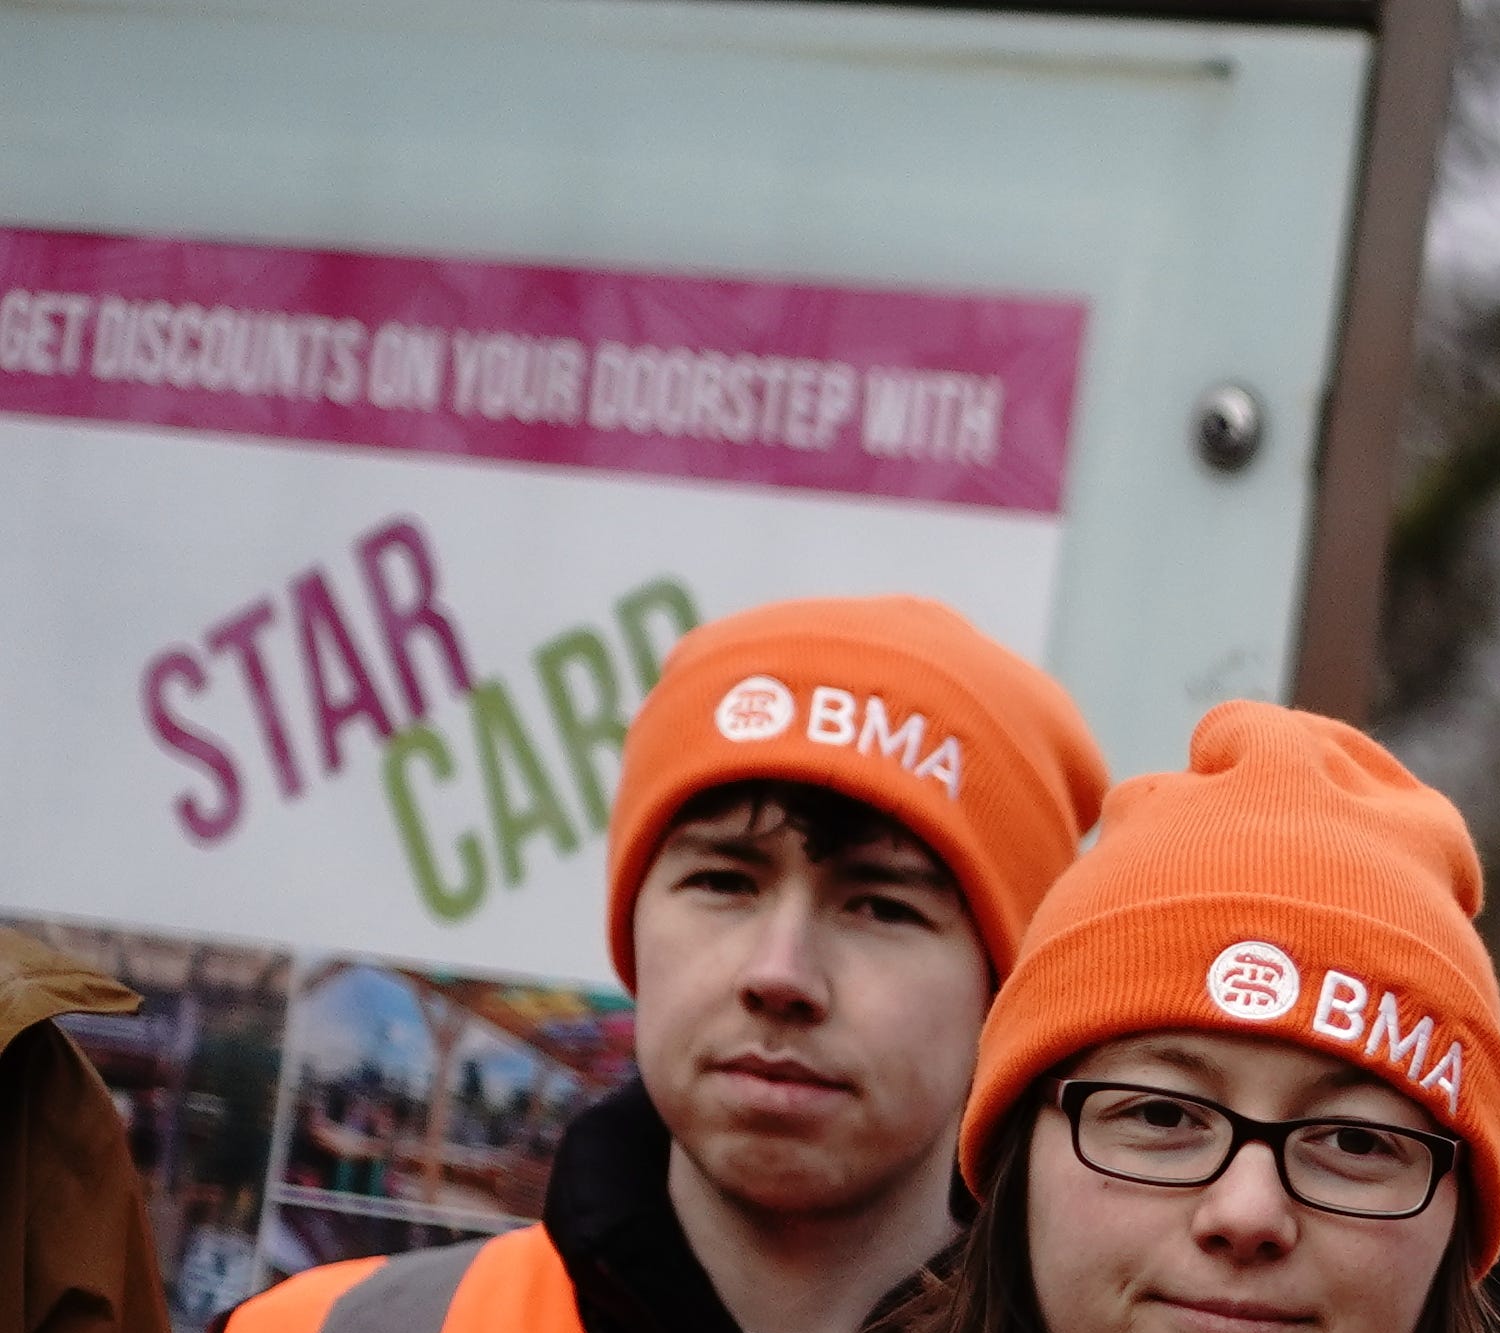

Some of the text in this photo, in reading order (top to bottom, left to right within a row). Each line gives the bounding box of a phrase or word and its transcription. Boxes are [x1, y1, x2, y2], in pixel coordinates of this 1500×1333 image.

[0, 289, 1000, 466] GET DISCOUNTS ON YOUR DOORSTEP WITH
[138, 513, 477, 852] STAR
[807, 686, 962, 799] BMA
[1312, 969, 1464, 1116] BMA
